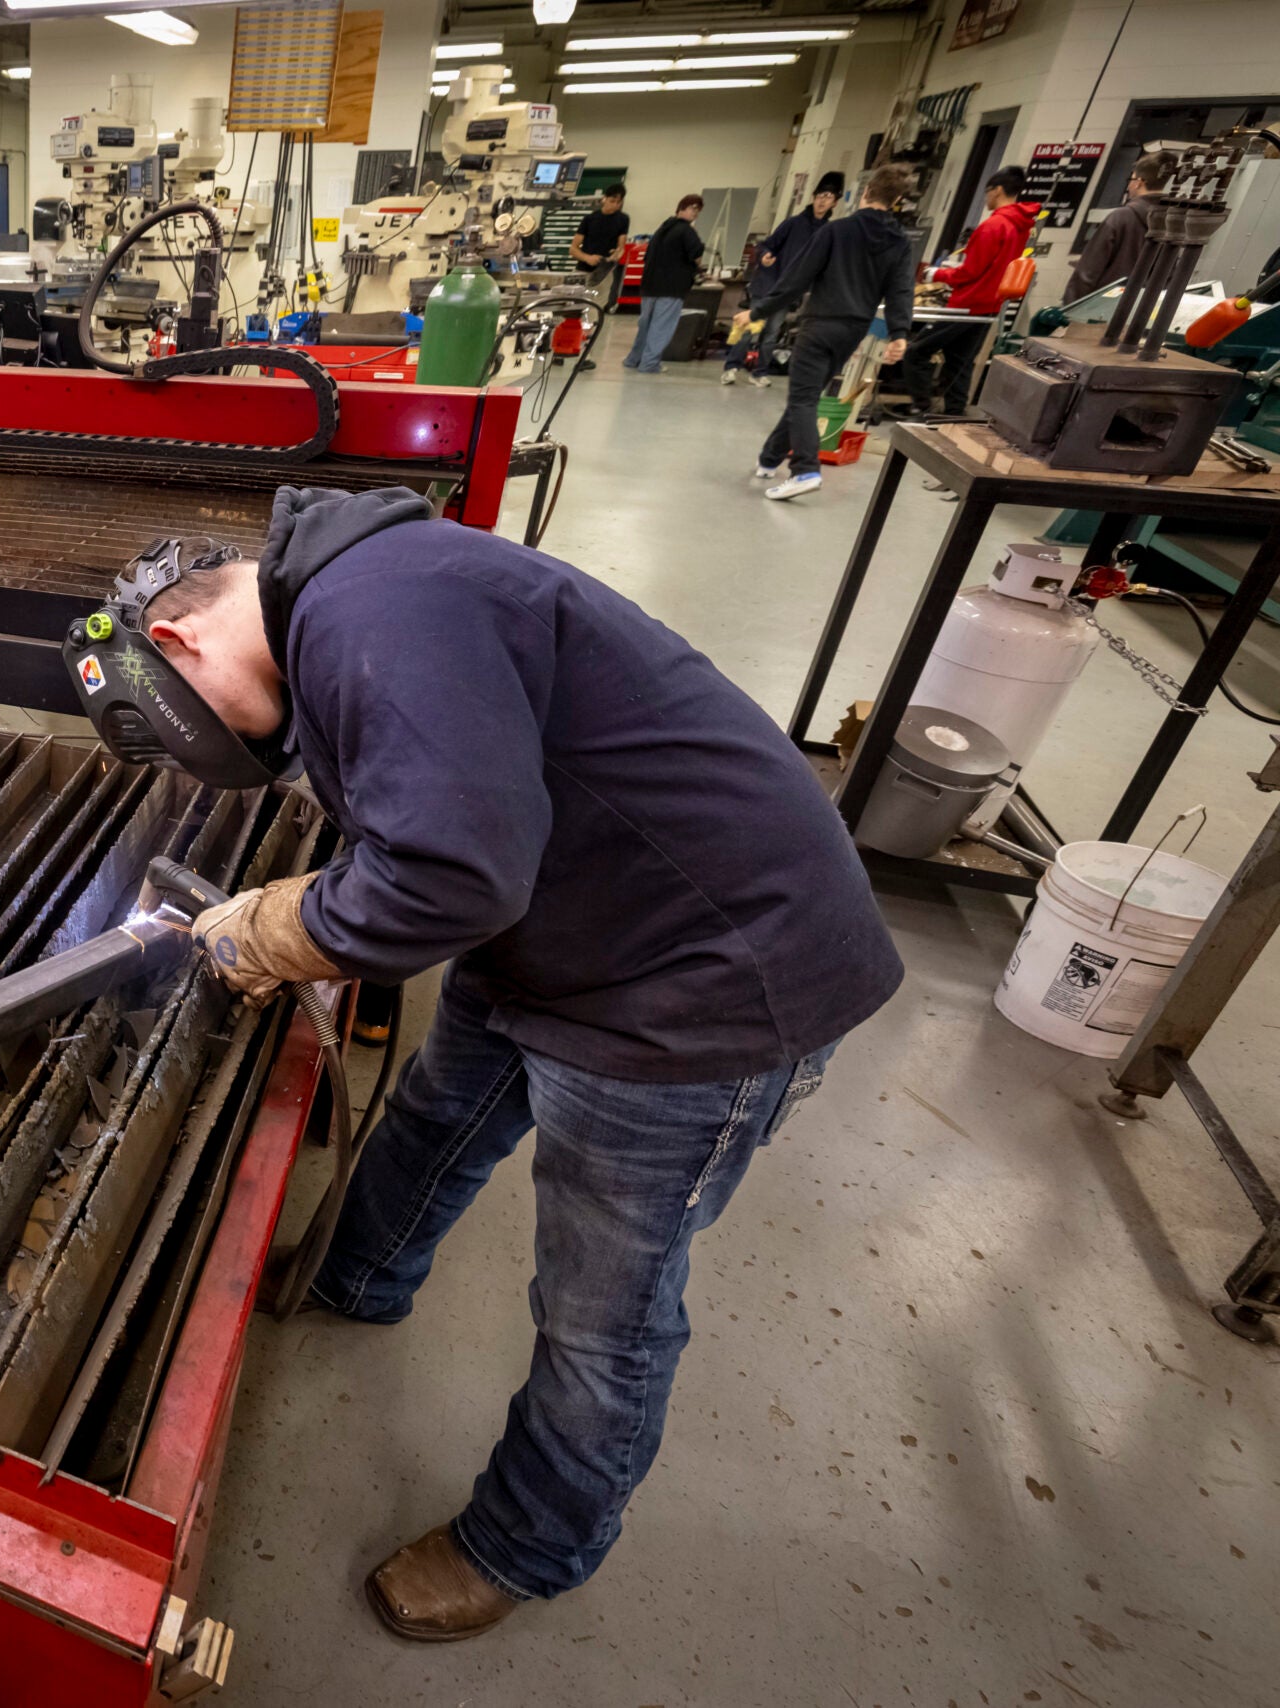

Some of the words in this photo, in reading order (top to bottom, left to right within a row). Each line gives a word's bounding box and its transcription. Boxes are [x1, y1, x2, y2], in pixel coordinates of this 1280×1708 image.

[531, 110, 551, 119] JET
[62, 119, 80, 130] JET
[1077, 145, 1102, 155] Rules
[1082, 947, 1117, 964] WARNING
